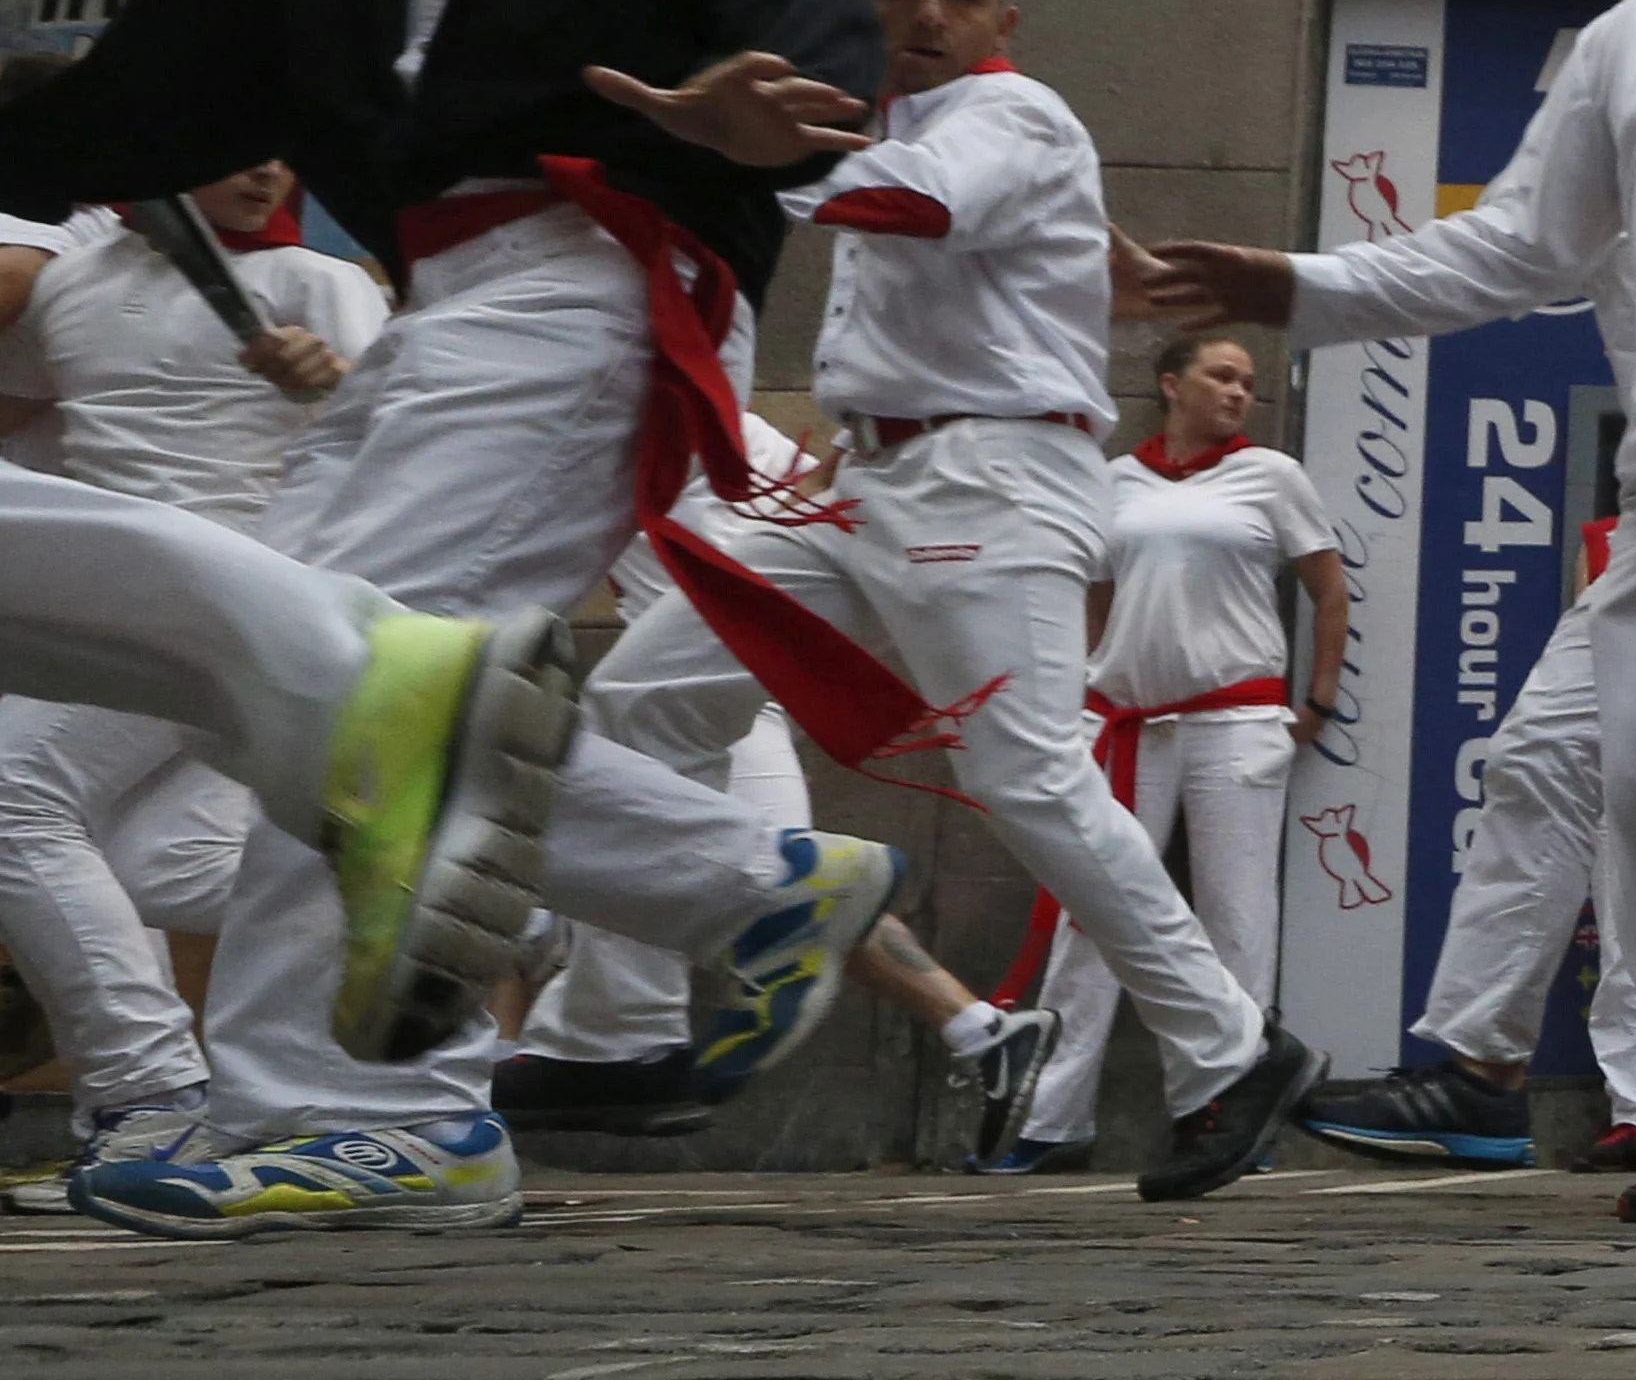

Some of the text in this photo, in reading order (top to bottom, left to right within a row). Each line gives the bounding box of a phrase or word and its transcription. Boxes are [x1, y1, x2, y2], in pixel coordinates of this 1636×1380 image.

[1355, 337, 1414, 519] com
[1465, 397, 1556, 553] 24
[1457, 569, 1516, 721] hour
